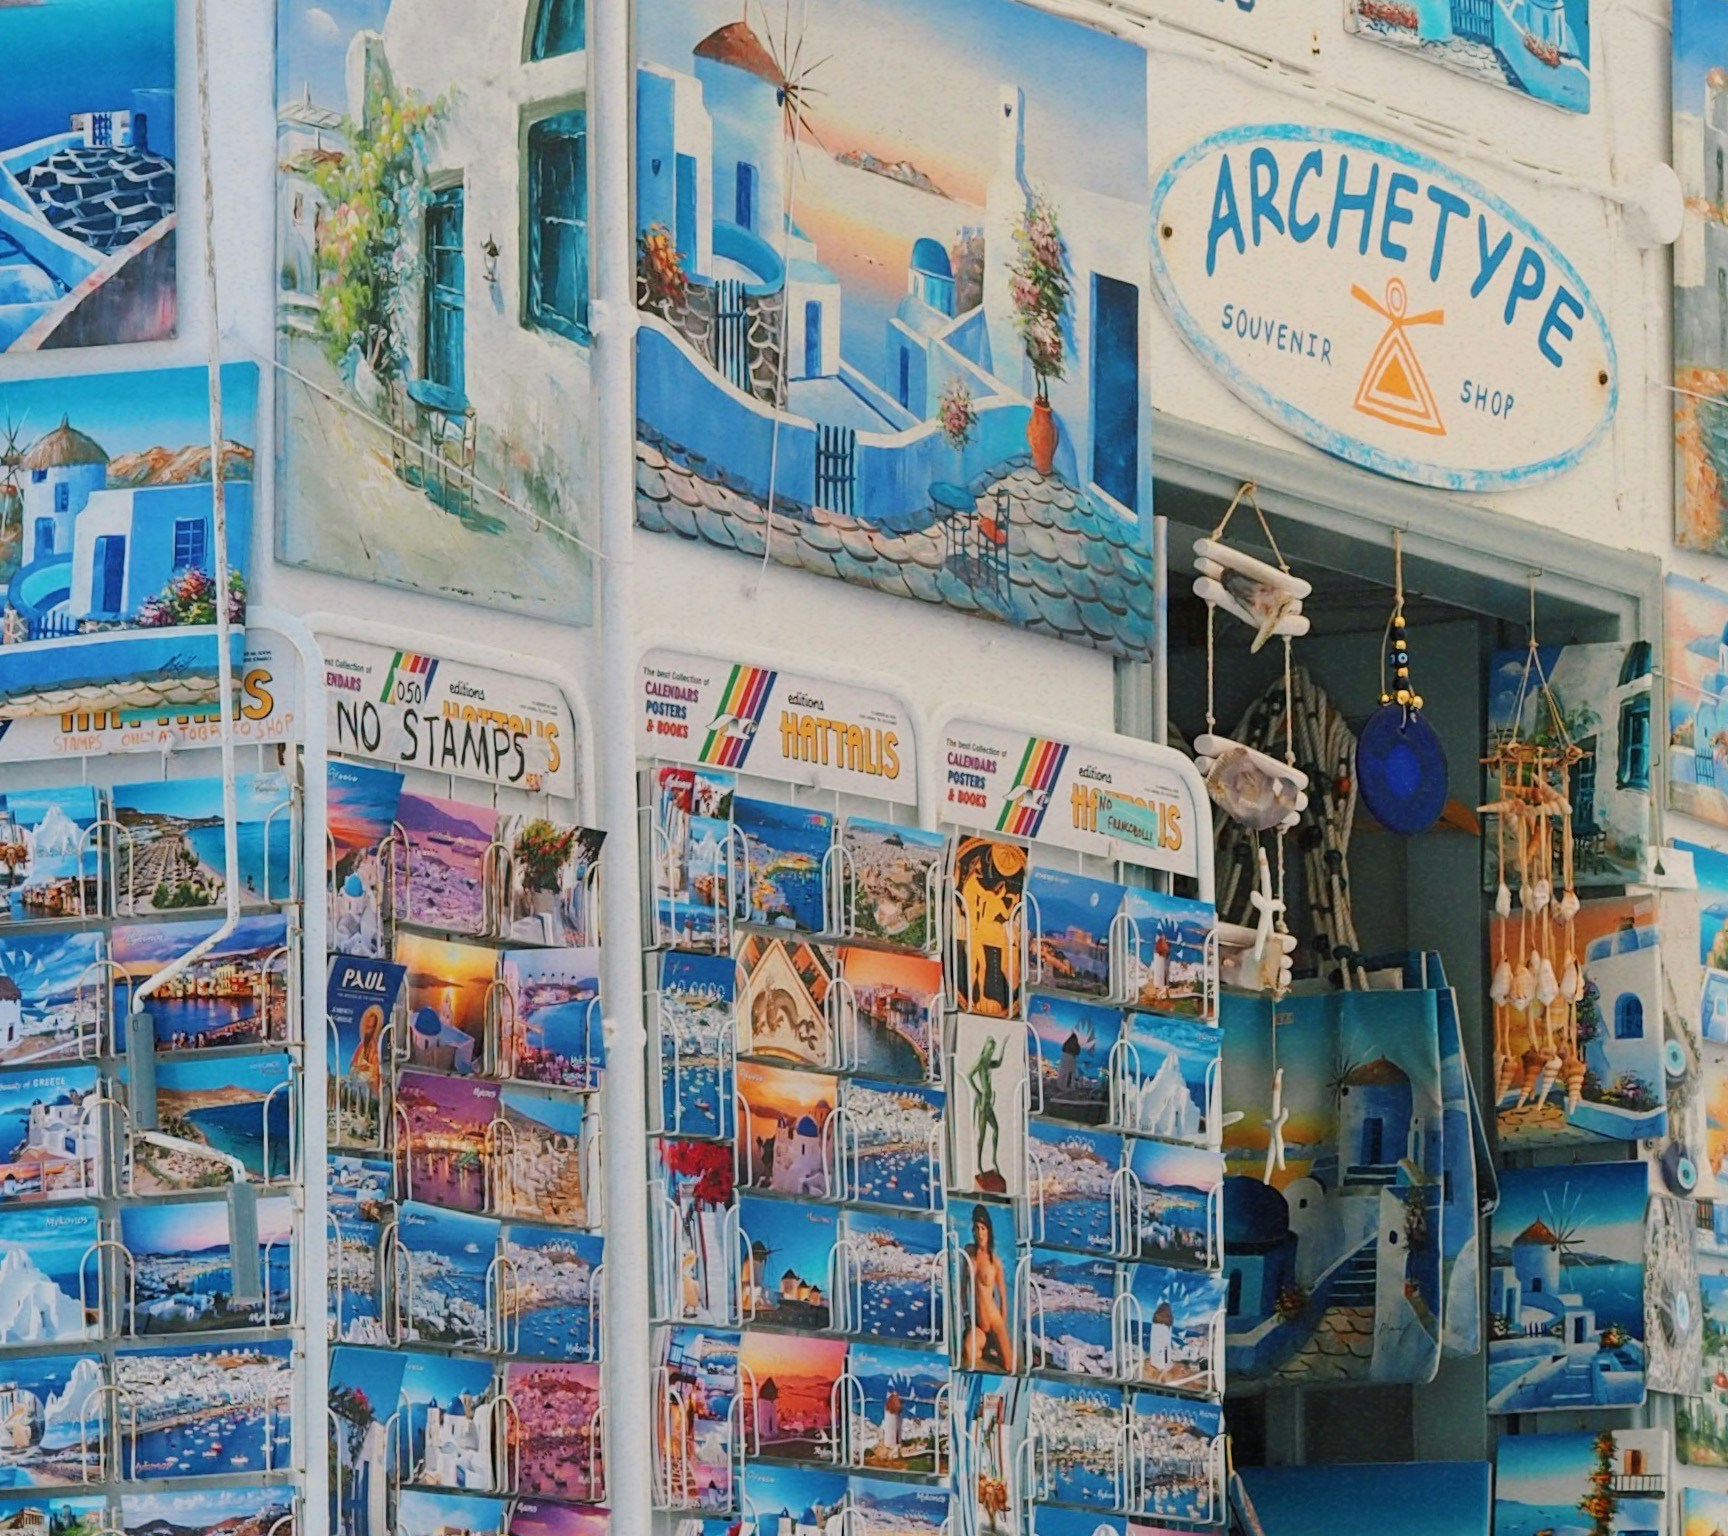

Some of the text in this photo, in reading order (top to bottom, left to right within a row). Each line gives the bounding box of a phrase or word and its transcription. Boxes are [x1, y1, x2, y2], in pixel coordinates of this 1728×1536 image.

[1206, 147, 1584, 368] ARCHETYPE
[1221, 304, 1332, 366] SOUVENIR
[1460, 379, 1514, 420] SHOP
[326, 671, 362, 693] ENDARS
[643, 667, 710, 686] The best Collection of
[449, 680, 486, 701] editions
[645, 681, 699, 703] CALENDARS
[788, 691, 825, 711] editions
[646, 699, 687, 720] POSTERS
[54, 734, 102, 753] STAMPS
[121, 731, 154, 747] ONLY
[180, 722, 250, 741] TOBACO
[256, 713, 294, 740] SHOP
[646, 719, 689, 739] & BOOKS
[337, 699, 382, 752] NO
[400, 708, 529, 782] STAMPS
[779, 709, 900, 780] HATTALIS
[947, 737, 957, 747] The
[957, 739, 972, 751] best
[972, 742, 1001, 756] Collection
[947, 751, 998, 774] CALENDARS
[947, 770, 986, 790] POSTERS
[1078, 765, 1112, 784] editions
[947, 789, 987, 809] & BOOKS
[1099, 795, 1113, 811] NO
[341, 968, 387, 992] PAUL
[32, 1076, 67, 1088] GREECE
